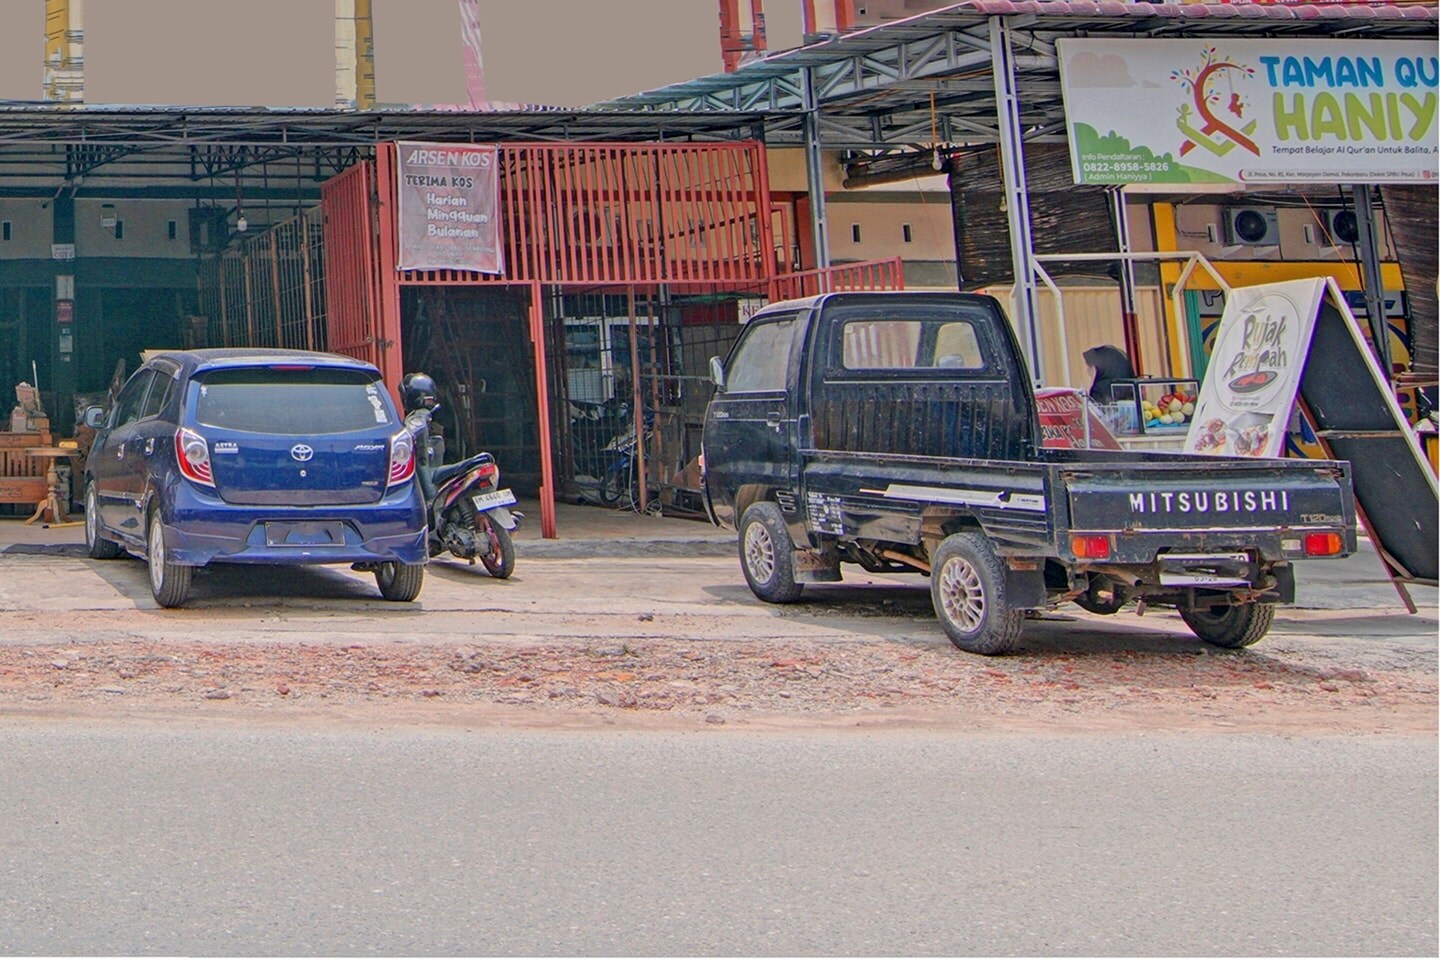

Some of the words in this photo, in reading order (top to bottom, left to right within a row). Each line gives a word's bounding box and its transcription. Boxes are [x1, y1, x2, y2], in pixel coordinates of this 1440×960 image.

[1259, 56, 1384, 87] TAMAN
[1273, 91, 1437, 141] HANIY
[1082, 153, 1097, 161] Info
[1272, 145, 1303, 155] Tempat
[1305, 145, 1335, 155] Belajar
[1348, 145, 1375, 155] Qur'an
[1377, 146, 1403, 154] Untuk
[1404, 146, 1431, 155] Balita,
[407, 149, 458, 165] ARSEN
[461, 151, 490, 167] KOS
[1083, 162, 1169, 172] 0822-8958-5826
[405, 175, 448, 188] TERIMA
[451, 177, 473, 188] KOS
[427, 192, 467, 206] Harian
[428, 224, 479, 238] Bulanan
[1242, 314, 1288, 351] Rujak
[1129, 491, 1290, 512] MITSUBISHI
